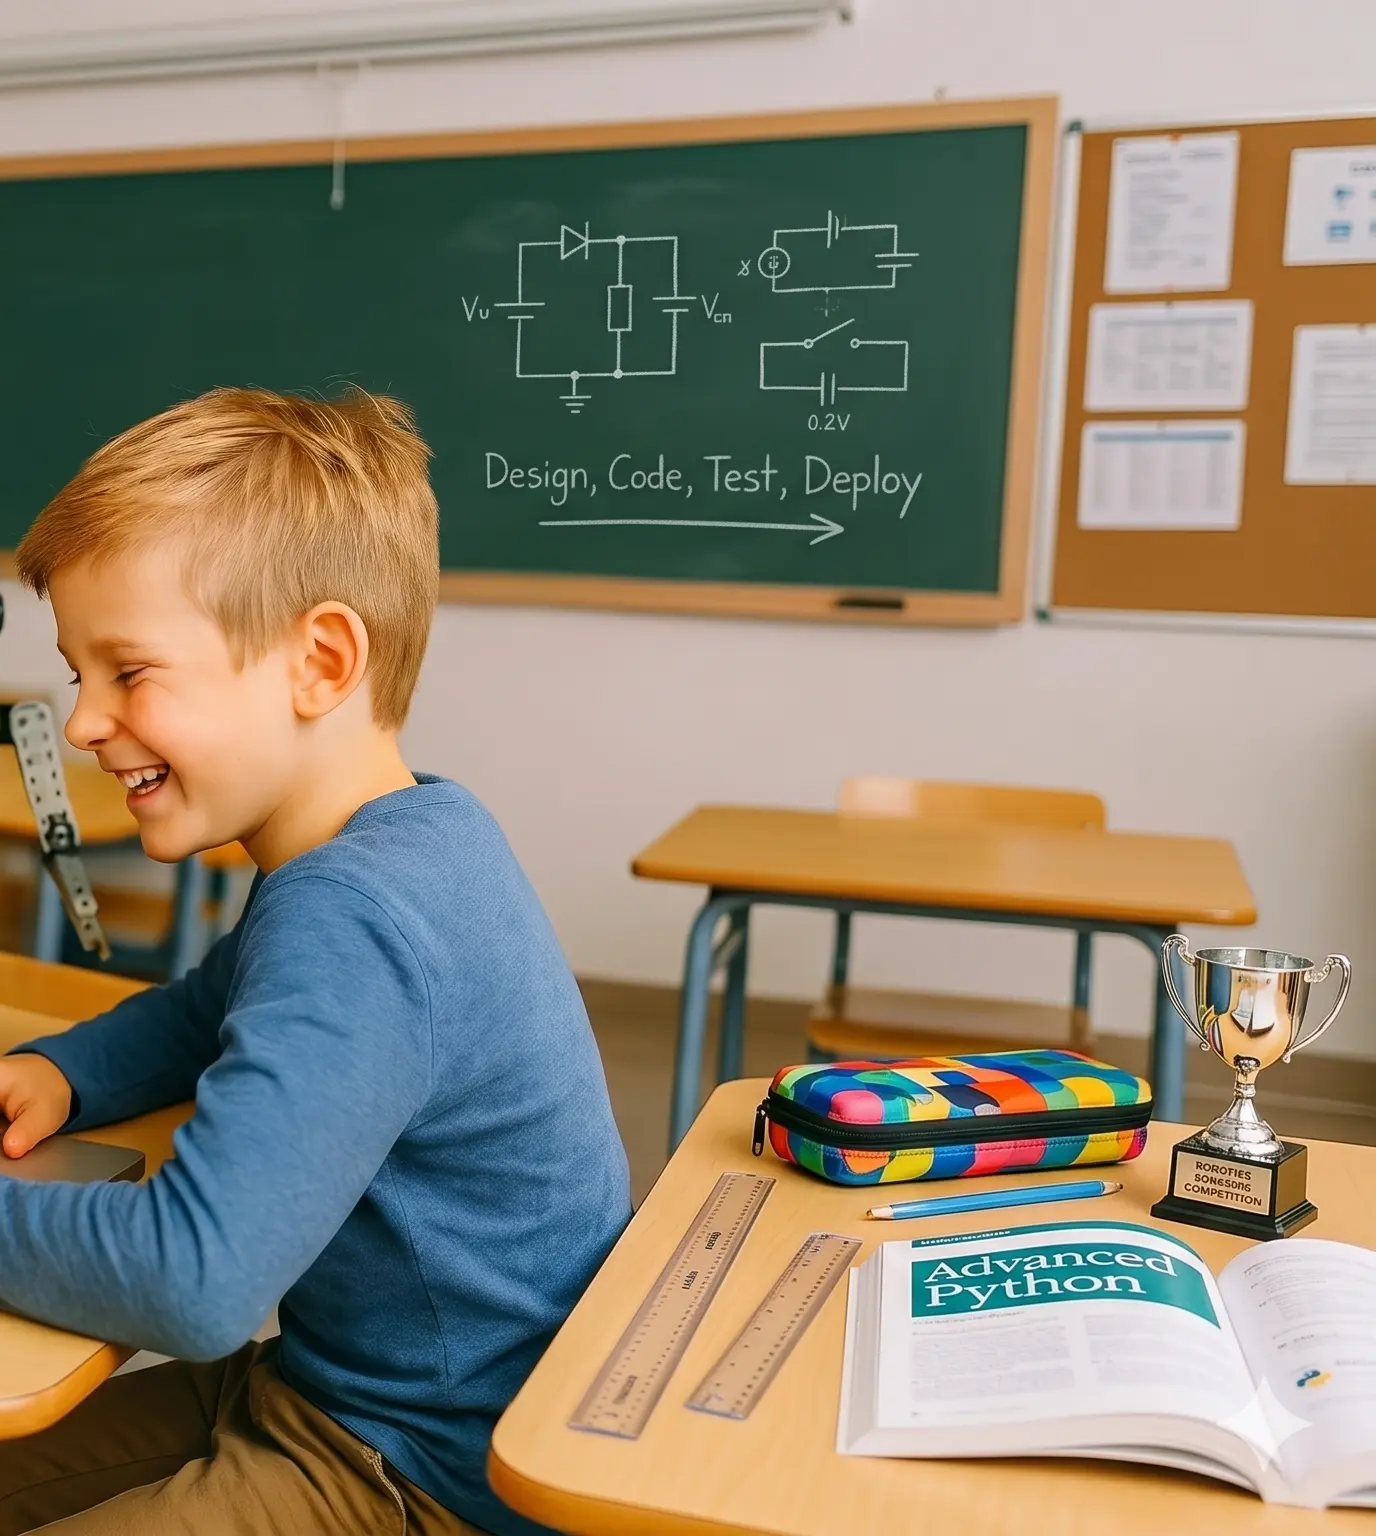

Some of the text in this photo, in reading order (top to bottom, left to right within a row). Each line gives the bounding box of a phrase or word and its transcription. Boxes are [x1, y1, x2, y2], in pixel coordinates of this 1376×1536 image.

[808, 413, 851, 431] 0.2V
[485, 452, 922, 518] Design, Code, Test, Deploy
[1184, 1183, 1262, 1206] COMPETITION
[923, 1250, 1177, 1283] Advanced
[925, 1272, 1146, 1309] Python
